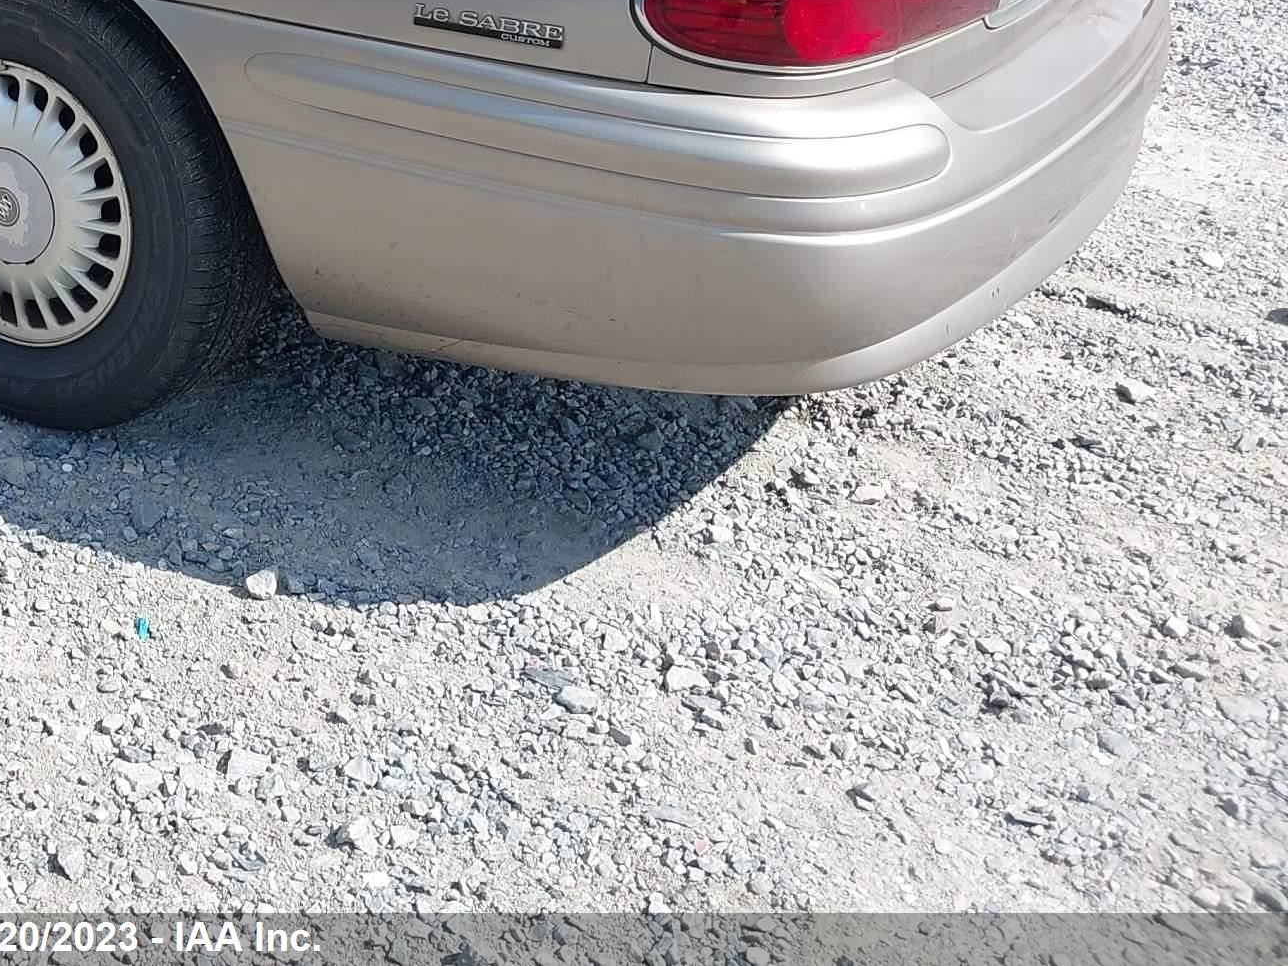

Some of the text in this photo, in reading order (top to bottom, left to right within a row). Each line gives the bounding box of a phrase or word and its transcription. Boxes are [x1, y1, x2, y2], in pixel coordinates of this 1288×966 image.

[414, 3, 563, 41] Le SABRE
[501, 34, 550, 47] CUSTOM
